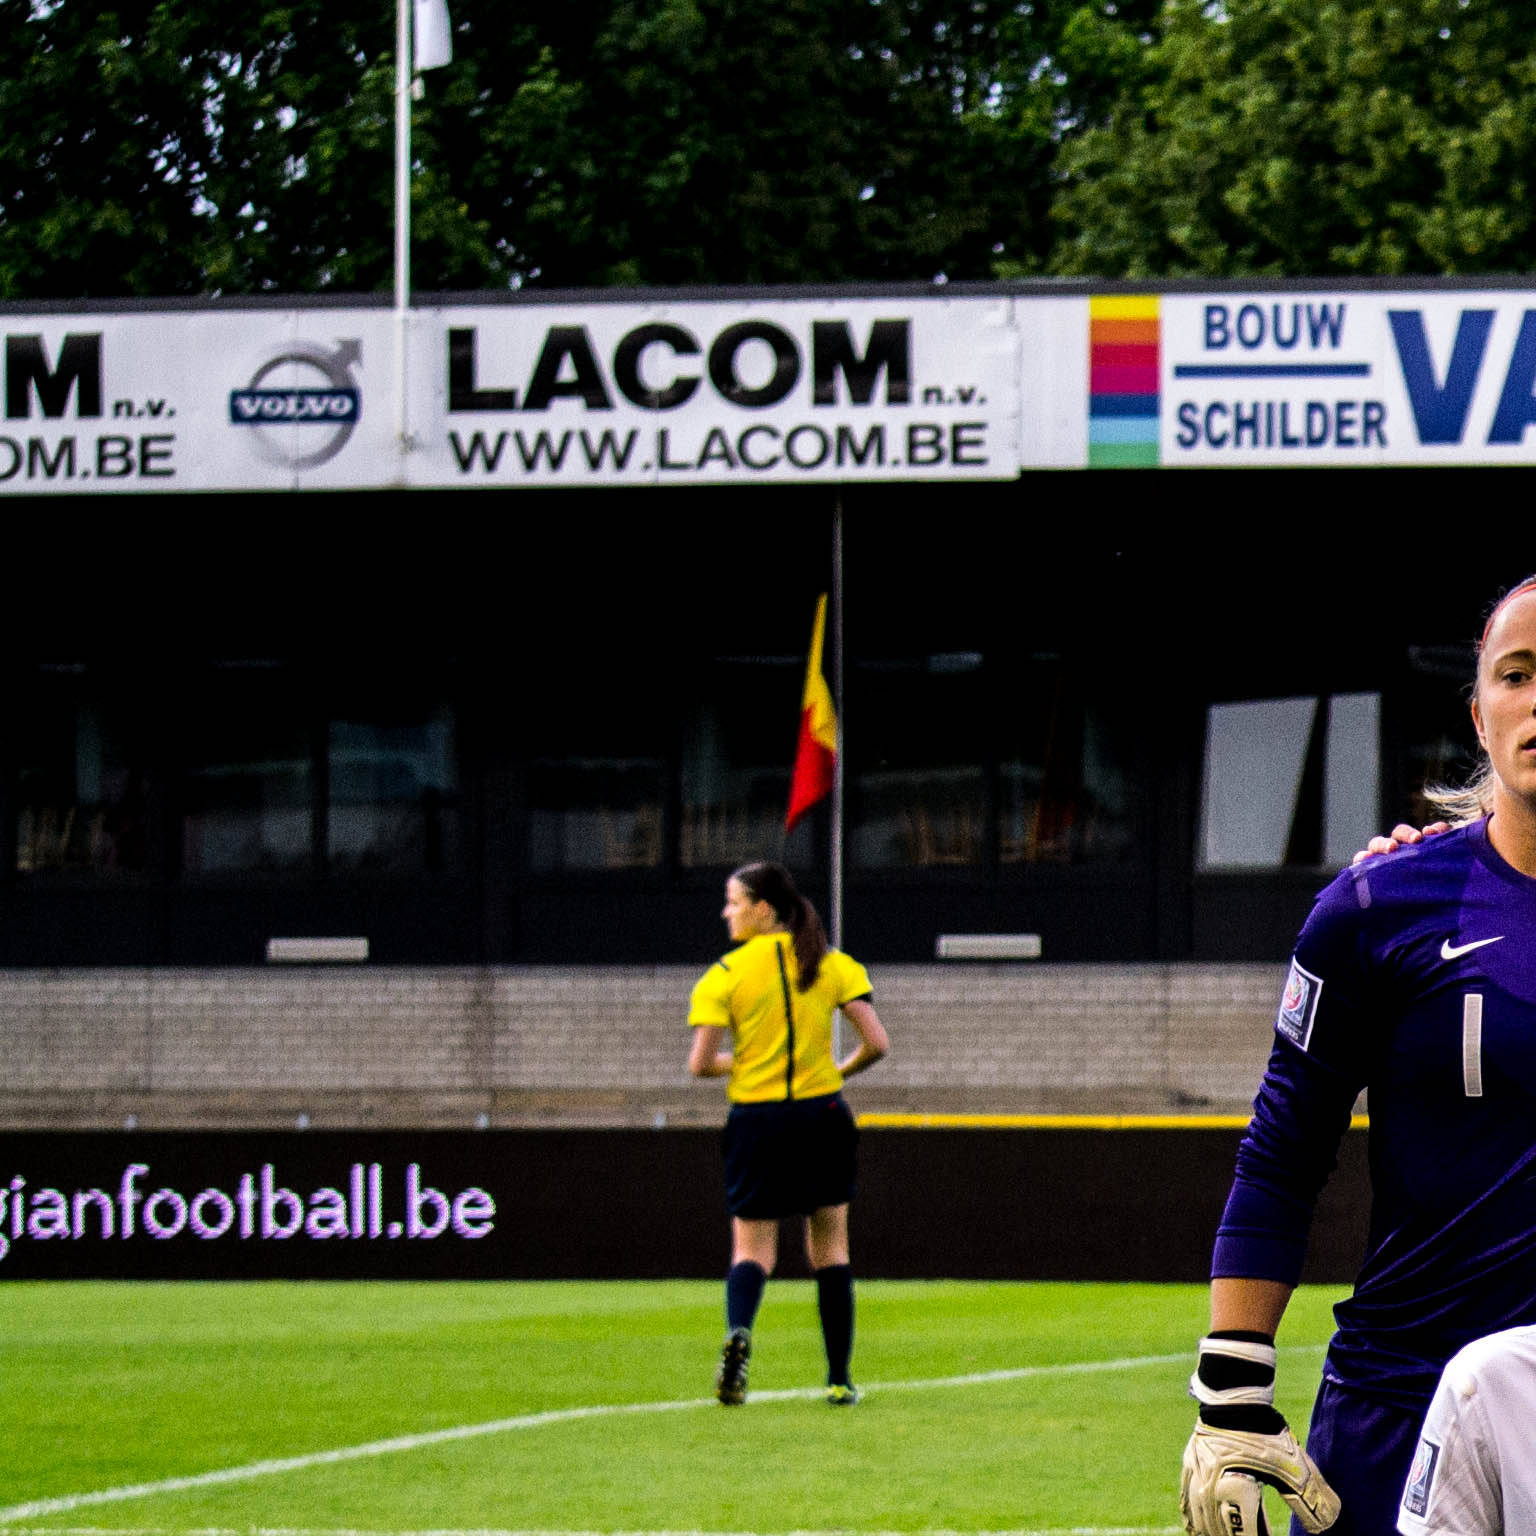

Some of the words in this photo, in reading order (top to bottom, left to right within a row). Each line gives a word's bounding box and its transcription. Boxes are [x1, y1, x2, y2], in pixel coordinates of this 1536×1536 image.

[1204, 304, 1346, 350] BOUW
[445, 319, 911, 413] LACOM
[923, 383, 986, 407] n.v.
[113, 398, 177, 419] n.v.
[235, 394, 354, 418] VOLVO
[1175, 400, 1389, 450] SCHILDER
[452, 420, 989, 474] WWW.LACOM.BE
[1462, 993, 1483, 1097] 1
